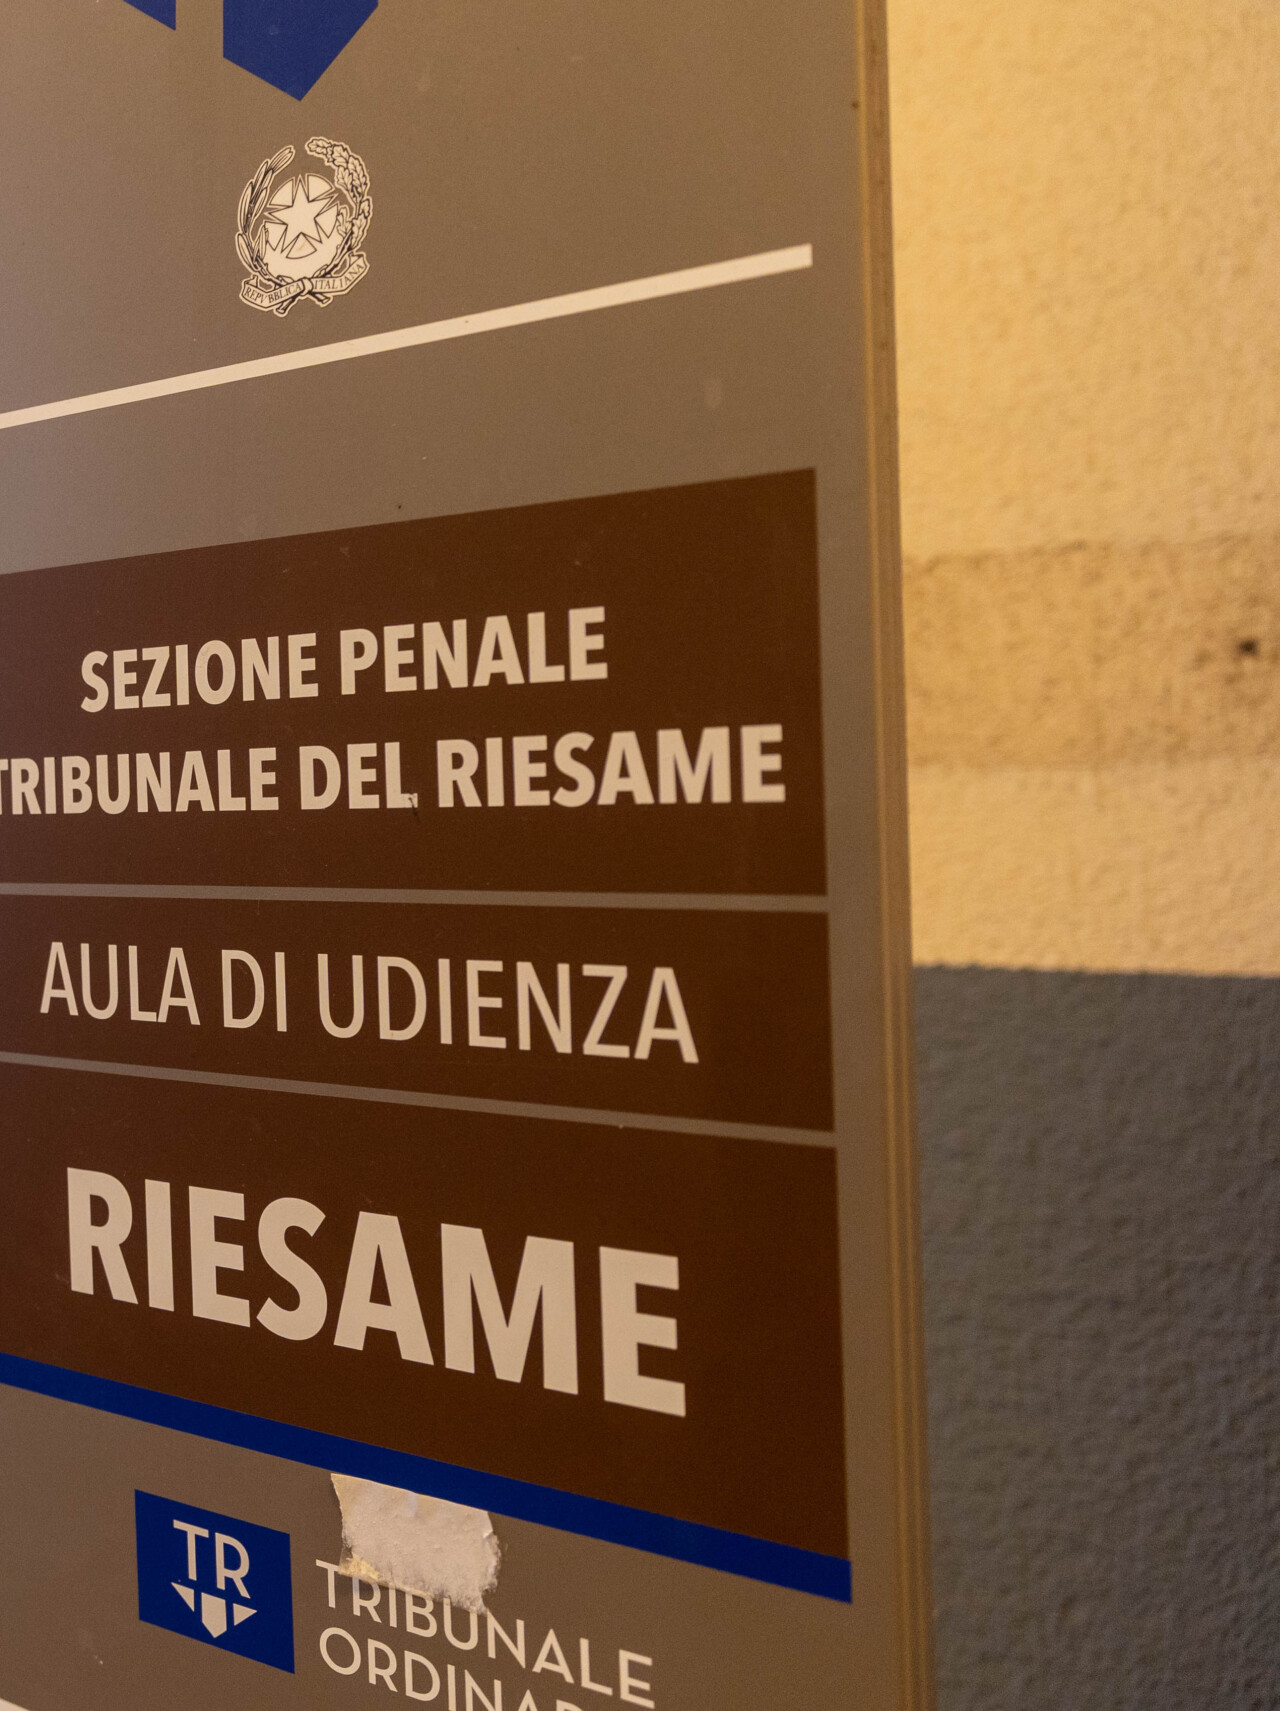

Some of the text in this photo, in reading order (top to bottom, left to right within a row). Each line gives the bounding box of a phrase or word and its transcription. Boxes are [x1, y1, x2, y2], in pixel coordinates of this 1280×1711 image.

[313, 263, 364, 290] ITALIANA
[80, 606, 608, 713] SEZIONE PENALE
[298, 741, 419, 810] DEL
[436, 724, 786, 808] RIESAME
[39, 941, 699, 1064] AULA DI UDIENZA
[66, 1166, 686, 1417] RIESAME
[173, 1519, 251, 1599] TR
[315, 1558, 655, 1710] TRIBUNALE
[319, 1626, 582, 1711] ORDIN
